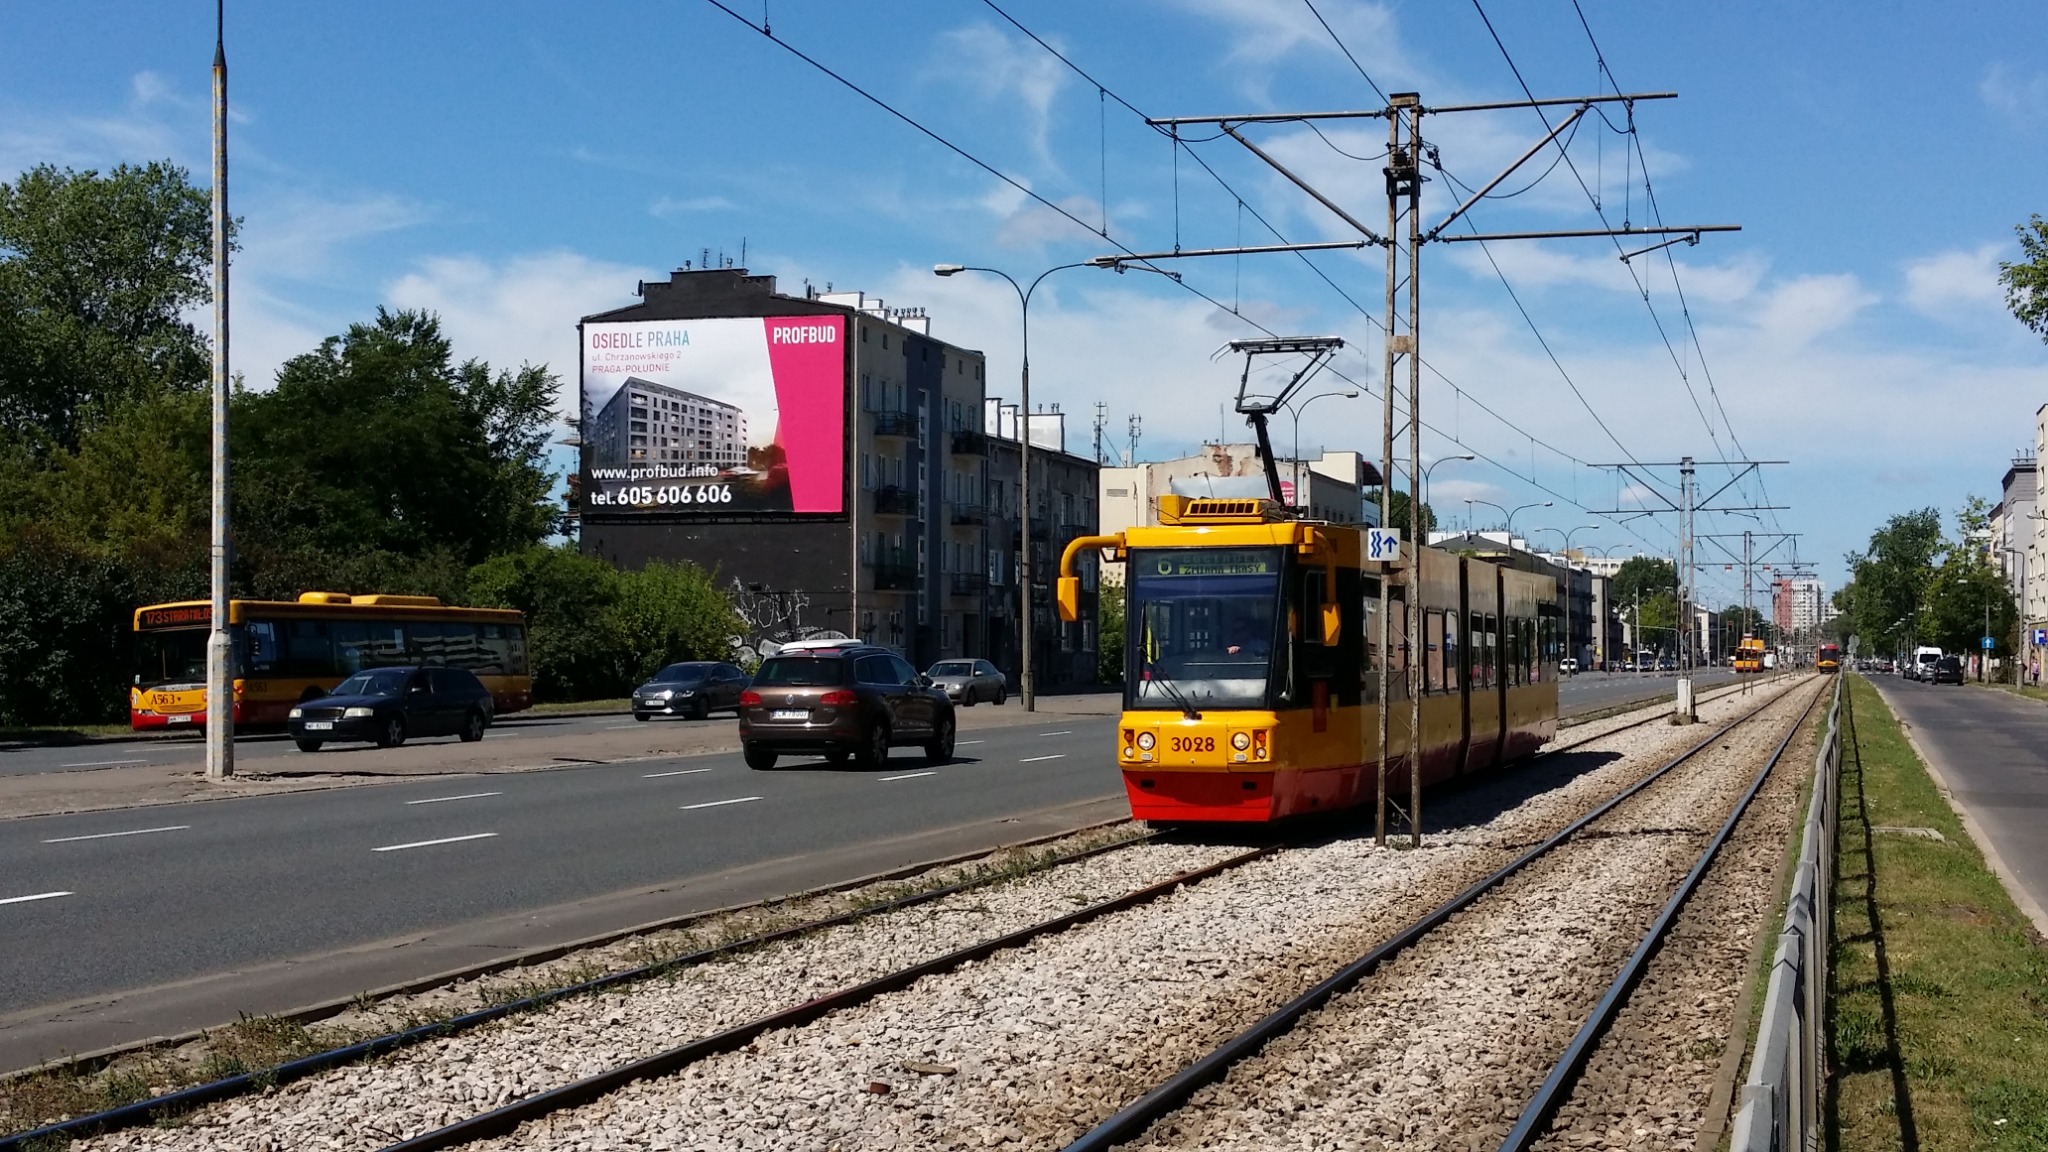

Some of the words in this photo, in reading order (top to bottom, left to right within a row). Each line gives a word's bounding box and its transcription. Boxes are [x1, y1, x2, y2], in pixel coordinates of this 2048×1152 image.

[592, 332, 643, 349] OSIEDLE
[648, 330, 690, 347] PRAHA
[773, 325, 836, 345] PROFBUD
[605, 351, 675, 362] Chrzanowskiego
[676, 350, 682, 359] 2
[592, 363, 670, 374] PRAGA-POŁUDNIE
[591, 463, 719, 482] www.profbud.info
[656, 485, 693, 505] 606
[696, 484, 732, 504] 606
[1229, 562, 1261, 574] TRASY
[145, 611, 163, 625] 173
[151, 693, 175, 705] A563
[1171, 736, 1215, 752] 3028
